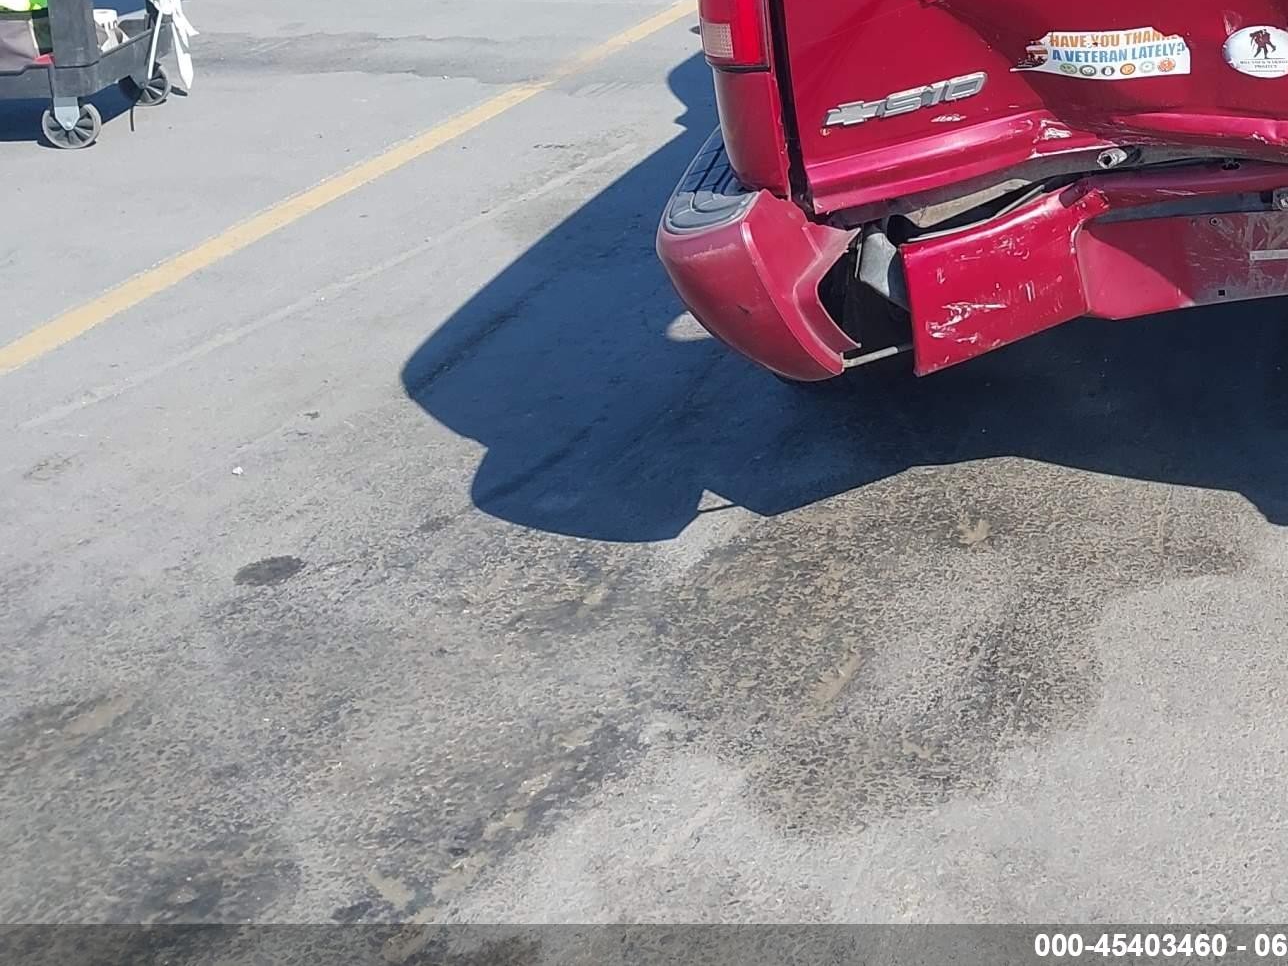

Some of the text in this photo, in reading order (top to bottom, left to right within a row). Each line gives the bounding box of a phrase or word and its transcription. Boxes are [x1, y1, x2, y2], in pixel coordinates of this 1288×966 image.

[1050, 33, 1089, 48] HAVE
[1090, 33, 1120, 48] YOU
[1052, 42, 1186, 63] A VETERAN LATELY?
